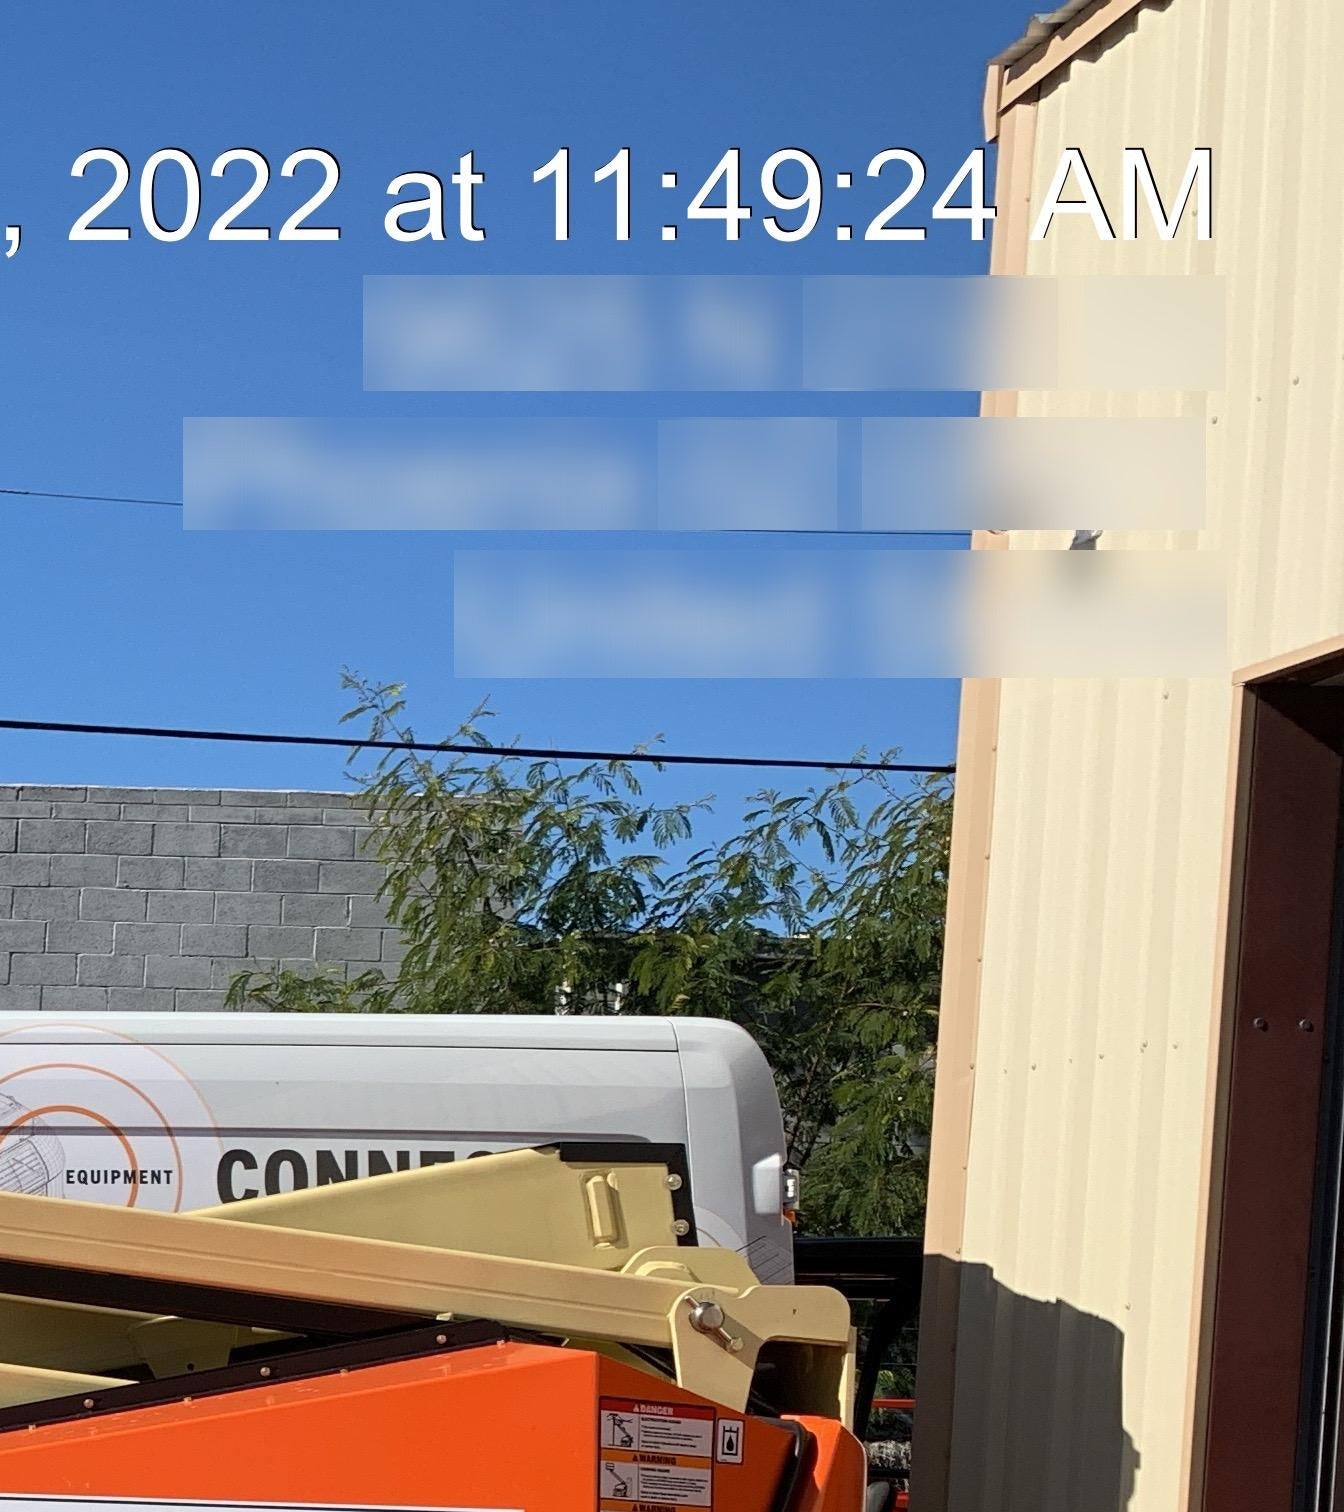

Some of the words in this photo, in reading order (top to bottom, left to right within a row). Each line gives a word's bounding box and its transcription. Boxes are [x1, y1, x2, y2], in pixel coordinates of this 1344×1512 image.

[66, 1169, 173, 1185] EQUIPMENT
[640, 1404, 674, 1416] DANGER
[640, 1455, 677, 1466] WARNING
